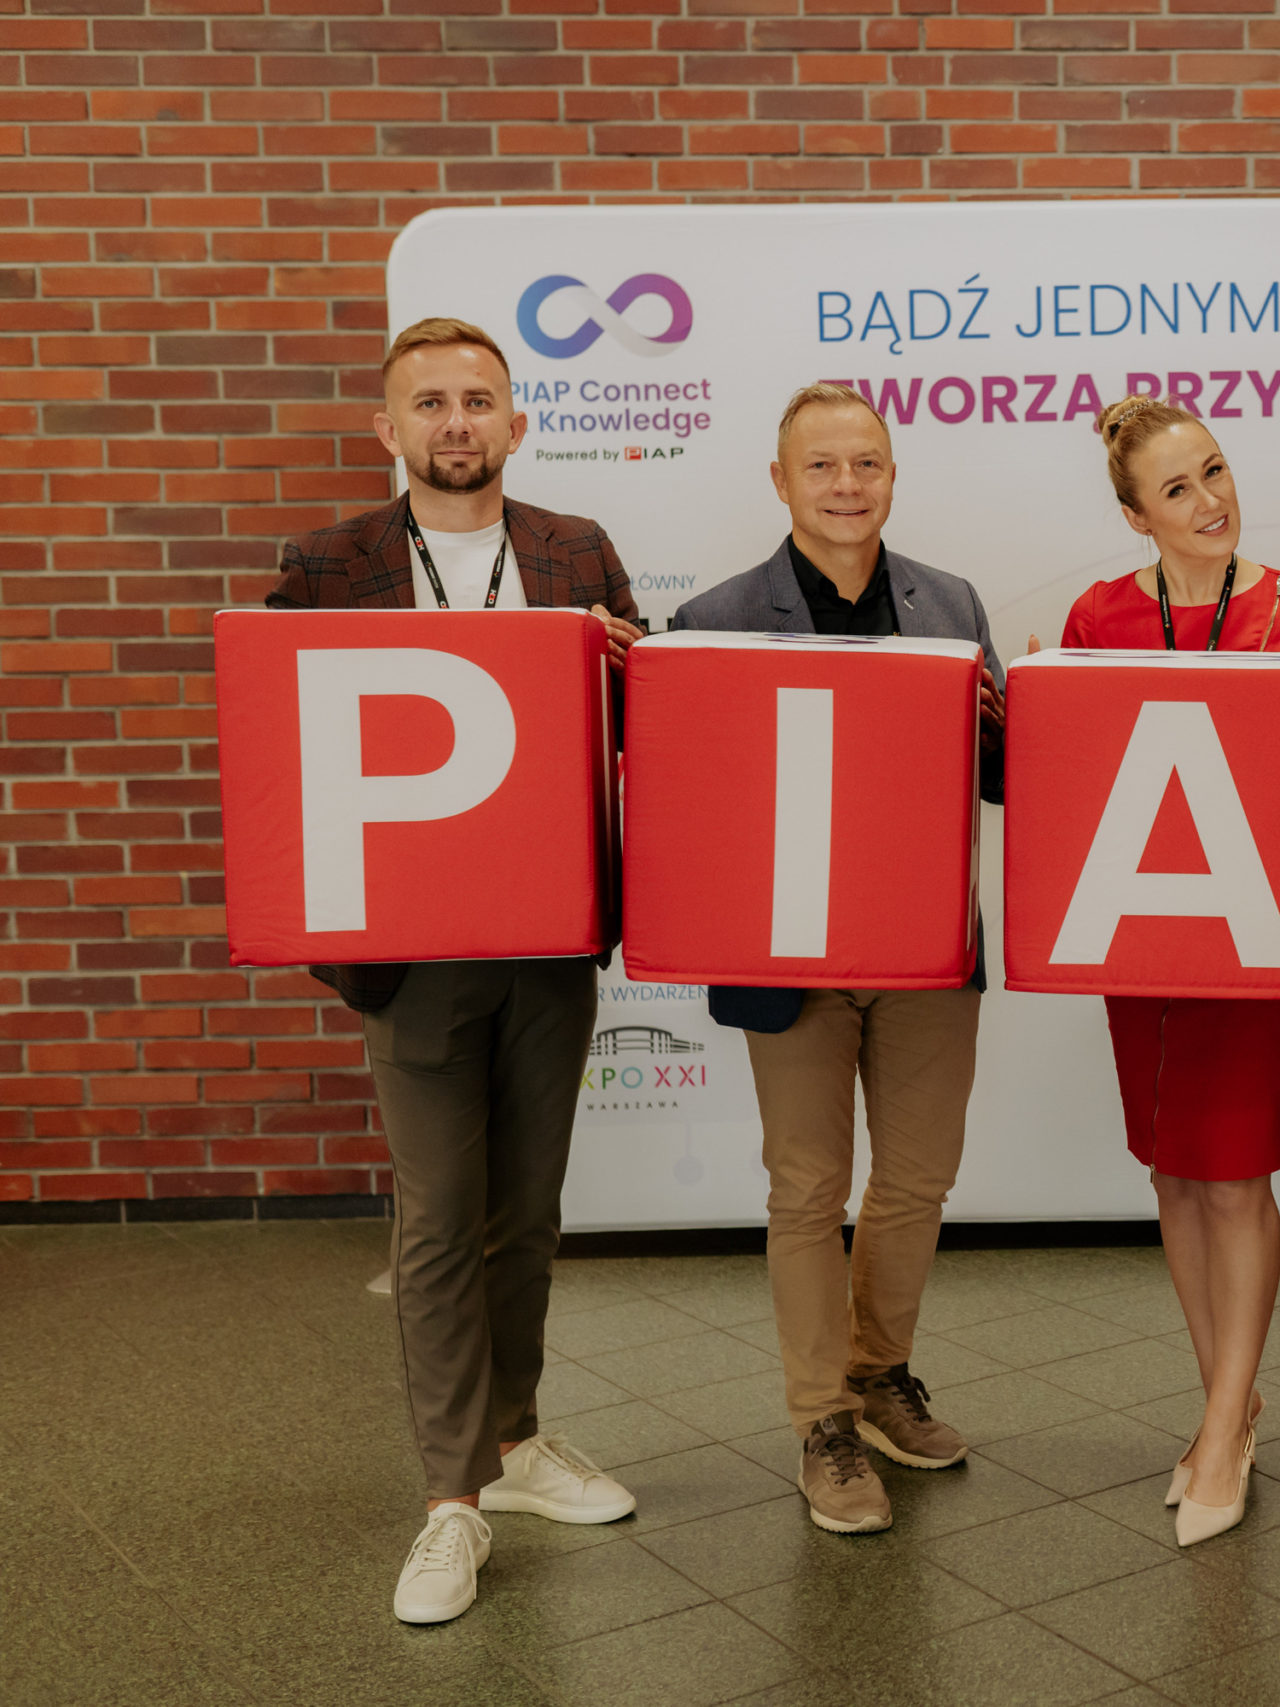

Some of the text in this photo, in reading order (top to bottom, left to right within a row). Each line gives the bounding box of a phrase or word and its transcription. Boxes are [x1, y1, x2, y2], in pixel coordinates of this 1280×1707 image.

[818, 273, 991, 355] BĄDŹ
[1015, 280, 1280, 339] JEDNYM
[579, 378, 712, 402] Connect
[817, 373, 1104, 435] WORZĄ
[538, 408, 712, 439] Knowledge
[536, 446, 684, 463] Powered by PIAP
[296, 647, 517, 934] P
[770, 687, 835, 958] I
[654, 1064, 707, 1089] XXI
[586, 1101, 679, 1112] WARSZAWA
